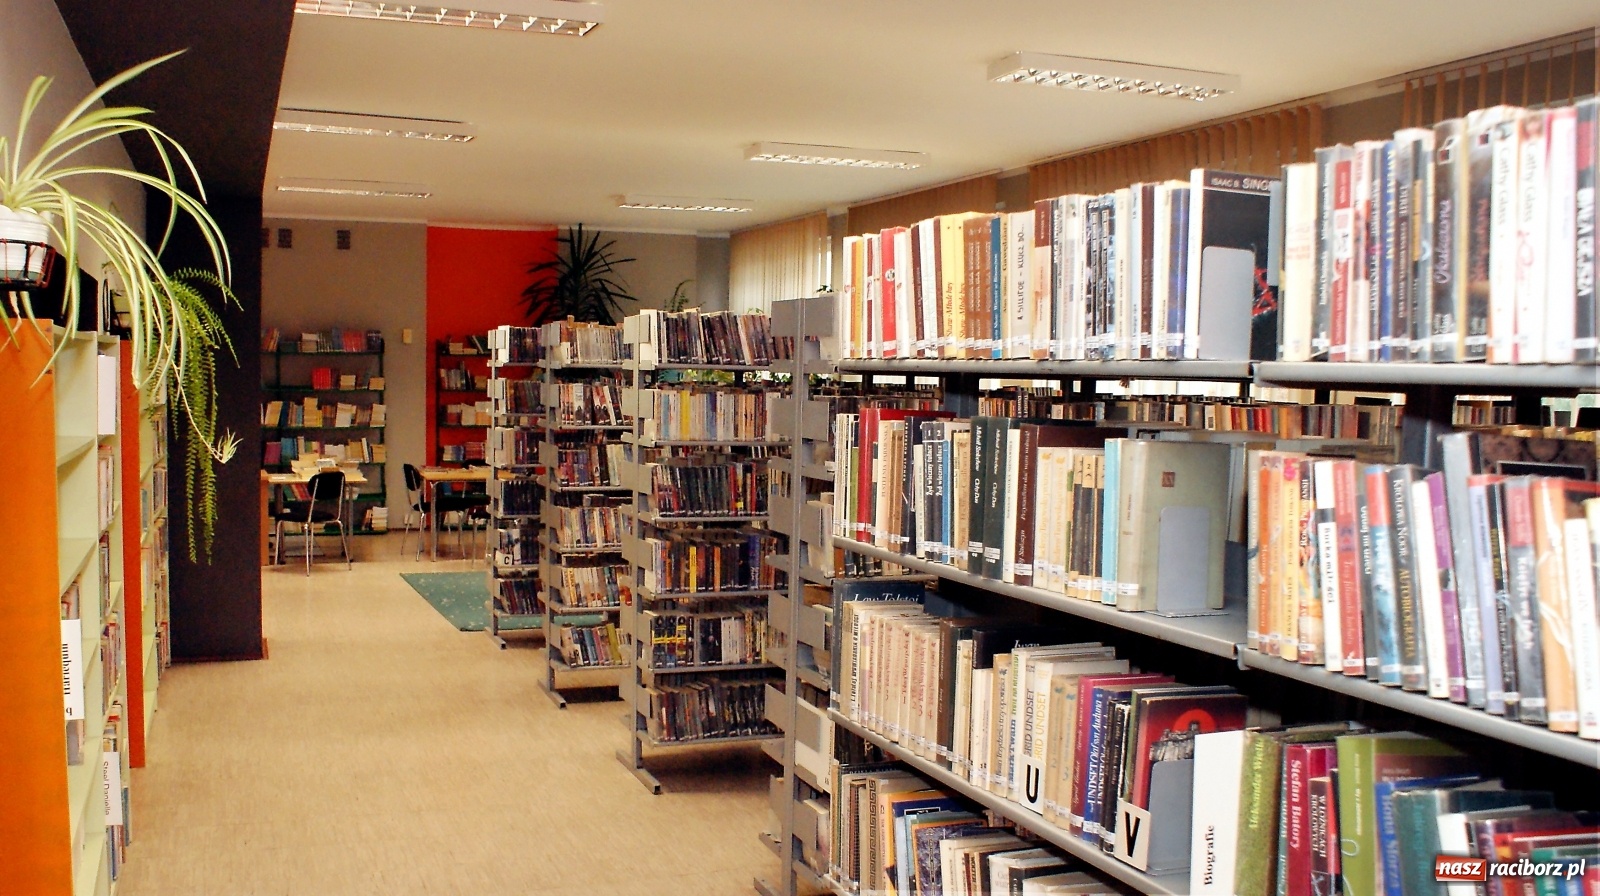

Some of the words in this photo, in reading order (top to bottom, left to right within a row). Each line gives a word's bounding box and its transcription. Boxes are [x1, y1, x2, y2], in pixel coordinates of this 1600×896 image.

[1242, 177, 1271, 191] SING
[1025, 688, 1036, 732] UNDSET
[1034, 691, 1047, 736] UNDSET
[1091, 699, 1103, 732] Auduna
[1088, 743, 1100, 763] Olaf
[1025, 764, 1040, 804] U
[1087, 761, 1099, 804] UNDSET
[1290, 759, 1303, 802] Stefan
[1318, 795, 1326, 804] W
[1124, 810, 1141, 859] V
[1289, 805, 1303, 851] Batory
[1310, 794, 1320, 851] KRÓLOWYCH
[1318, 804, 1328, 858] ŁOŻNICACH
[1203, 824, 1216, 886] Biografie
